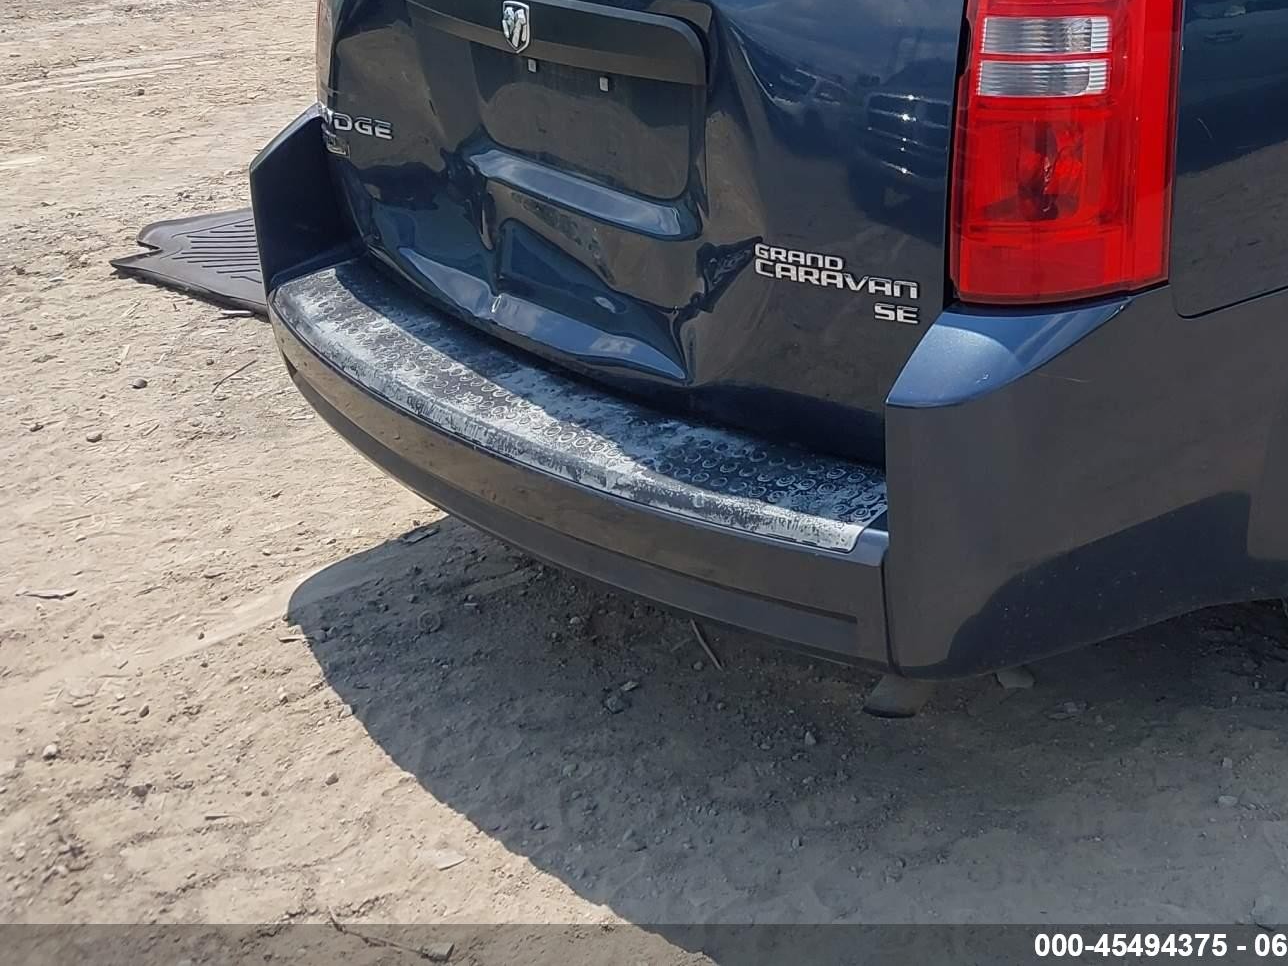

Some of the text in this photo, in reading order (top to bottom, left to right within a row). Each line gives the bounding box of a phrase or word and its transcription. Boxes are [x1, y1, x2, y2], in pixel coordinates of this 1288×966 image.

[326, 111, 393, 140] DGE
[754, 242, 844, 271] GRAND
[754, 258, 919, 299] CARAVAN
[873, 302, 919, 325] SE
